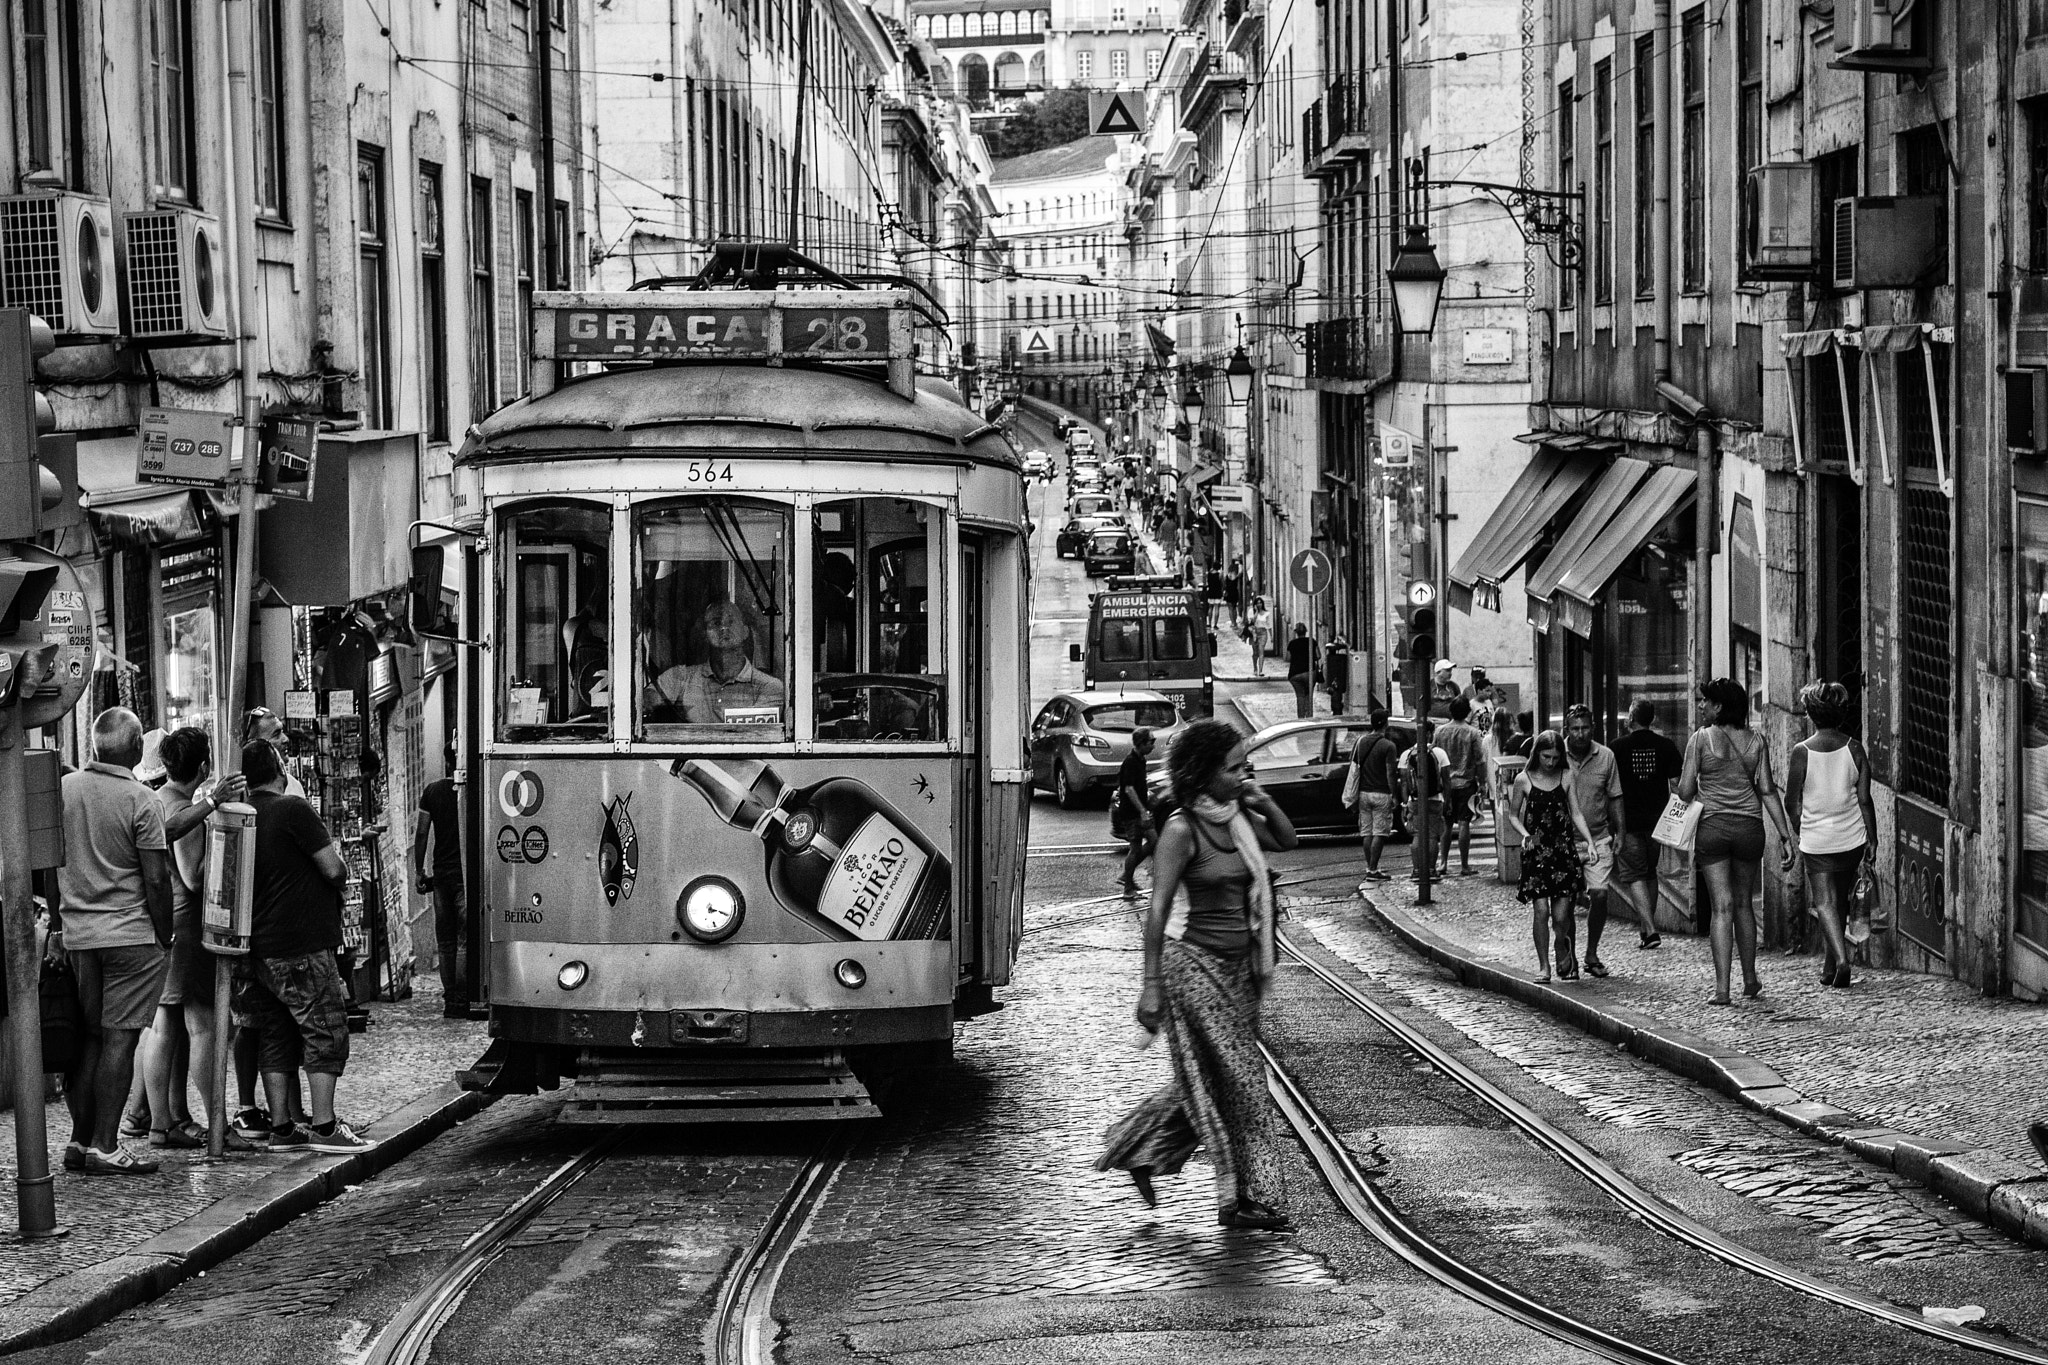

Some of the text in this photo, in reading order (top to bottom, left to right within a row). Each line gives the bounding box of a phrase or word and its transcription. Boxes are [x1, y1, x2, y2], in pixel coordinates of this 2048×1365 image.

[569, 313, 750, 345] GRAÇA
[807, 316, 868, 351] 28
[174, 442, 219, 454] 737 28E
[143, 460, 163, 469] 3599
[688, 462, 733, 482] 564
[1103, 594, 1188, 607] AMBULÂNCIA
[1103, 606, 1188, 618] EMERGÊNCIA
[69, 636, 91, 645] 6285
[852, 853, 878, 893] LICOR
[843, 837, 904, 929] BEIRÃO
[872, 901, 886, 921] LICOR
[883, 891, 891, 900] DE
[890, 857, 909, 890] PORTUGAL
[504, 909, 543, 924] BEIRÃO
